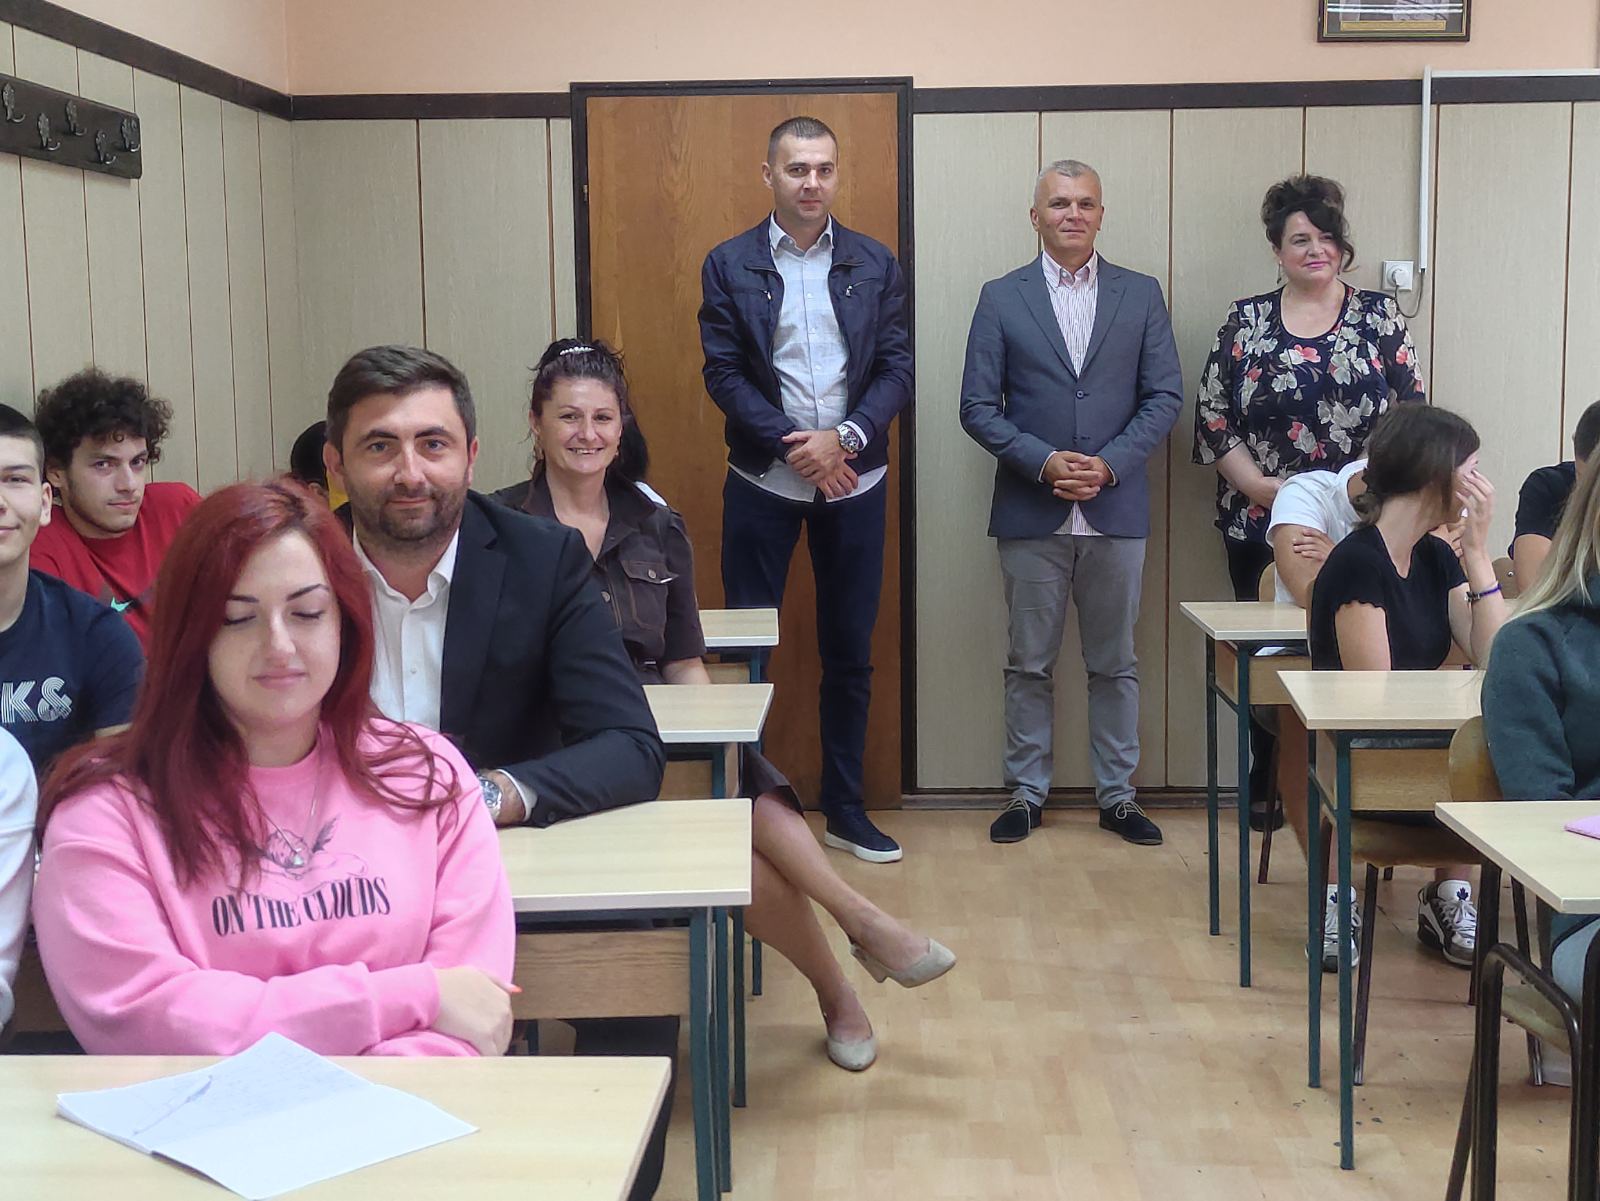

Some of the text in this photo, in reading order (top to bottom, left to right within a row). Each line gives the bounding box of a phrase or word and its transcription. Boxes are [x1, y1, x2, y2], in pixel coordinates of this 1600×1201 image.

[212, 877, 391, 937] ON THE CLOUDS
